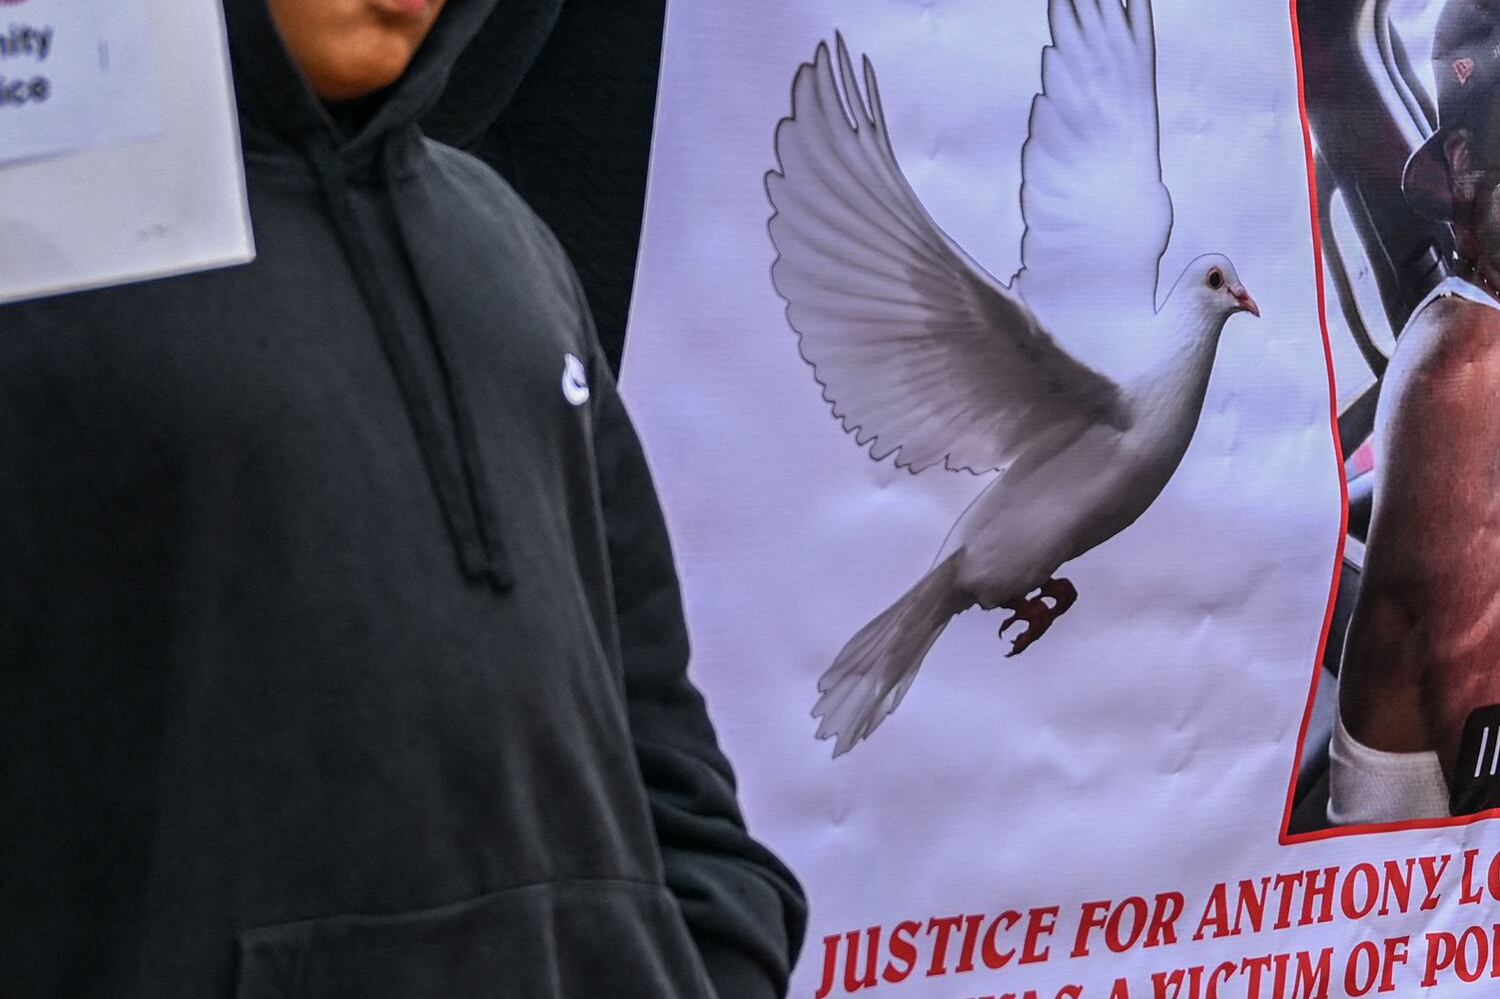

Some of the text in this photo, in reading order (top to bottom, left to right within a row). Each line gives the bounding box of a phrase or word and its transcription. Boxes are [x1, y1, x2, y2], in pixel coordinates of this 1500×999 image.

[1474, 726, 1490, 778] I
[814, 905, 1060, 999] JUSTICE
[1070, 891, 1185, 958] FOR
[1192, 854, 1452, 942] ANTHONY
[1343, 936, 1410, 998] OF
